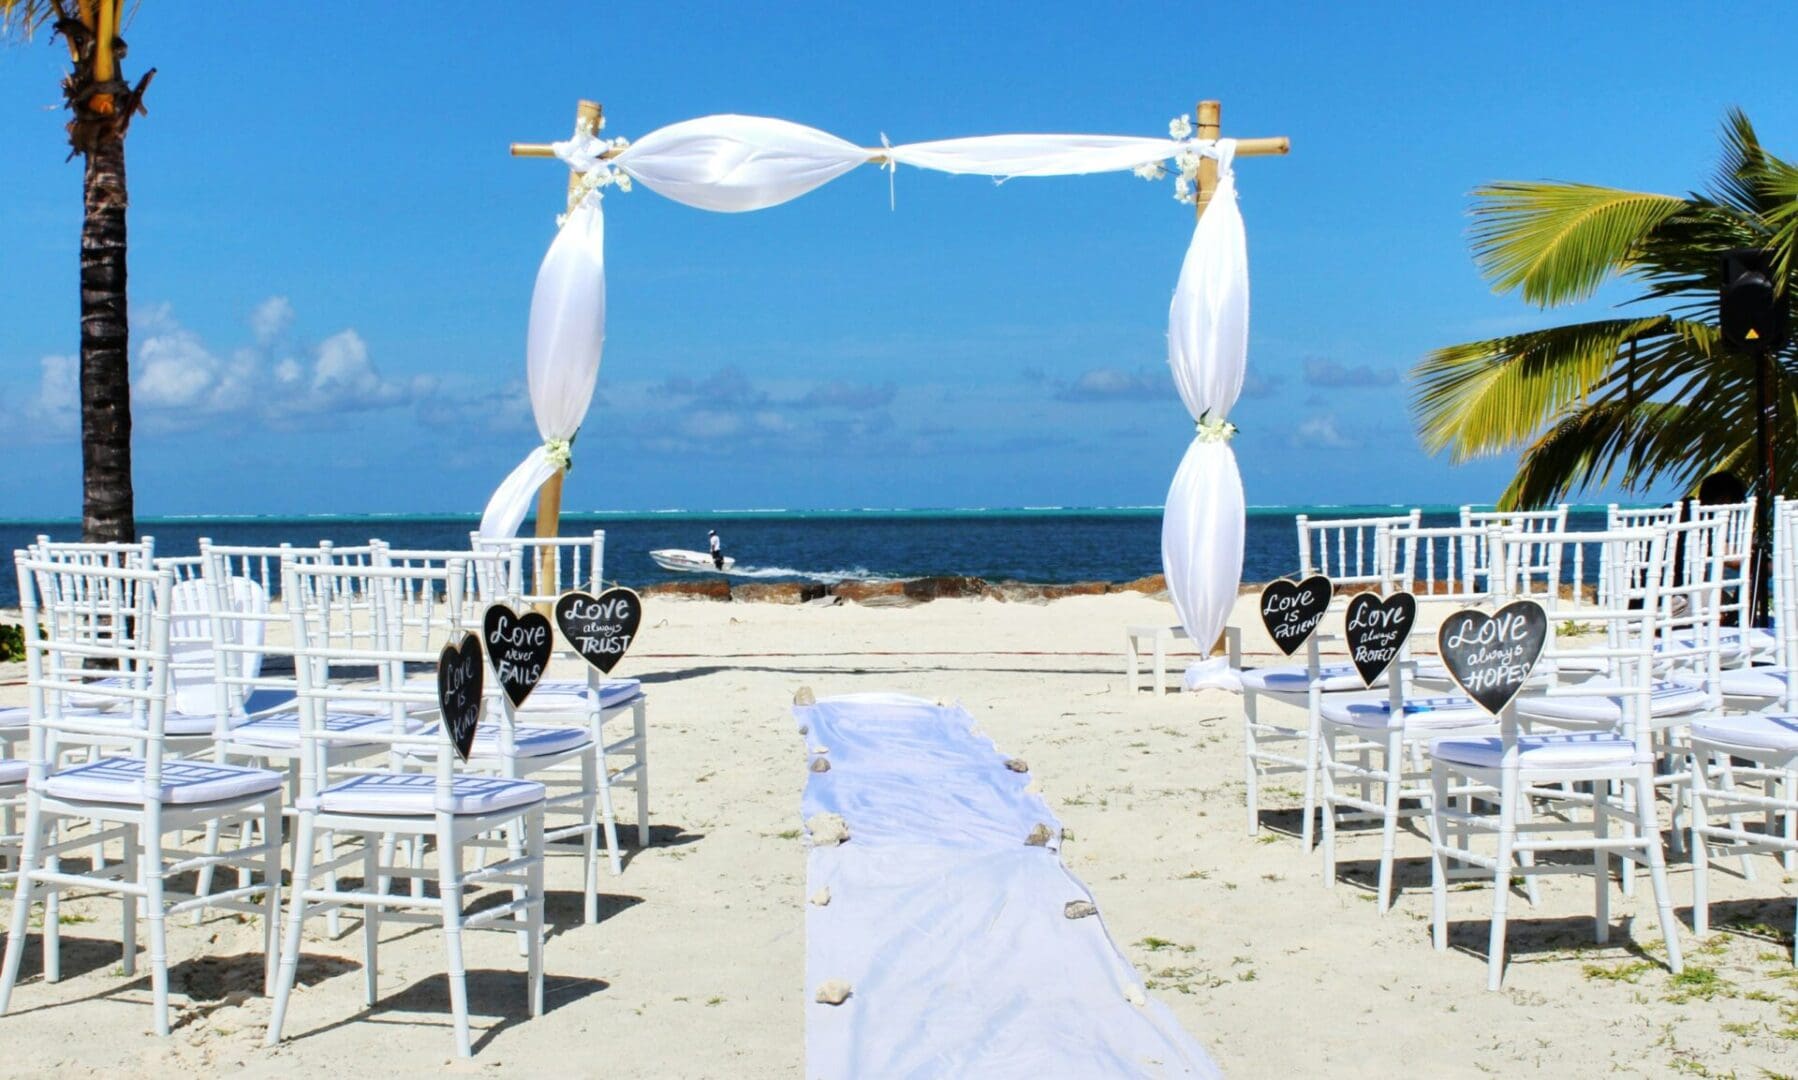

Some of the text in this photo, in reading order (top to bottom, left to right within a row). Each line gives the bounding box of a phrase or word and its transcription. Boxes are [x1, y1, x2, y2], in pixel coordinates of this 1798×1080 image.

[564, 598, 630, 620] Love
[1263, 590, 1315, 616] Love
[1348, 601, 1406, 631] Love
[490, 615, 545, 647] Love
[582, 622, 622, 637] always
[1273, 611, 1324, 639] PATIENT
[1447, 613, 1529, 649] Love
[575, 635, 632, 654] TRUST
[1354, 645, 1396, 663] PROTECT
[1467, 645, 1523, 666] always
[444, 656, 473, 705] Love
[497, 659, 541, 686] FAILS
[1462, 662, 1531, 691] HOPES
